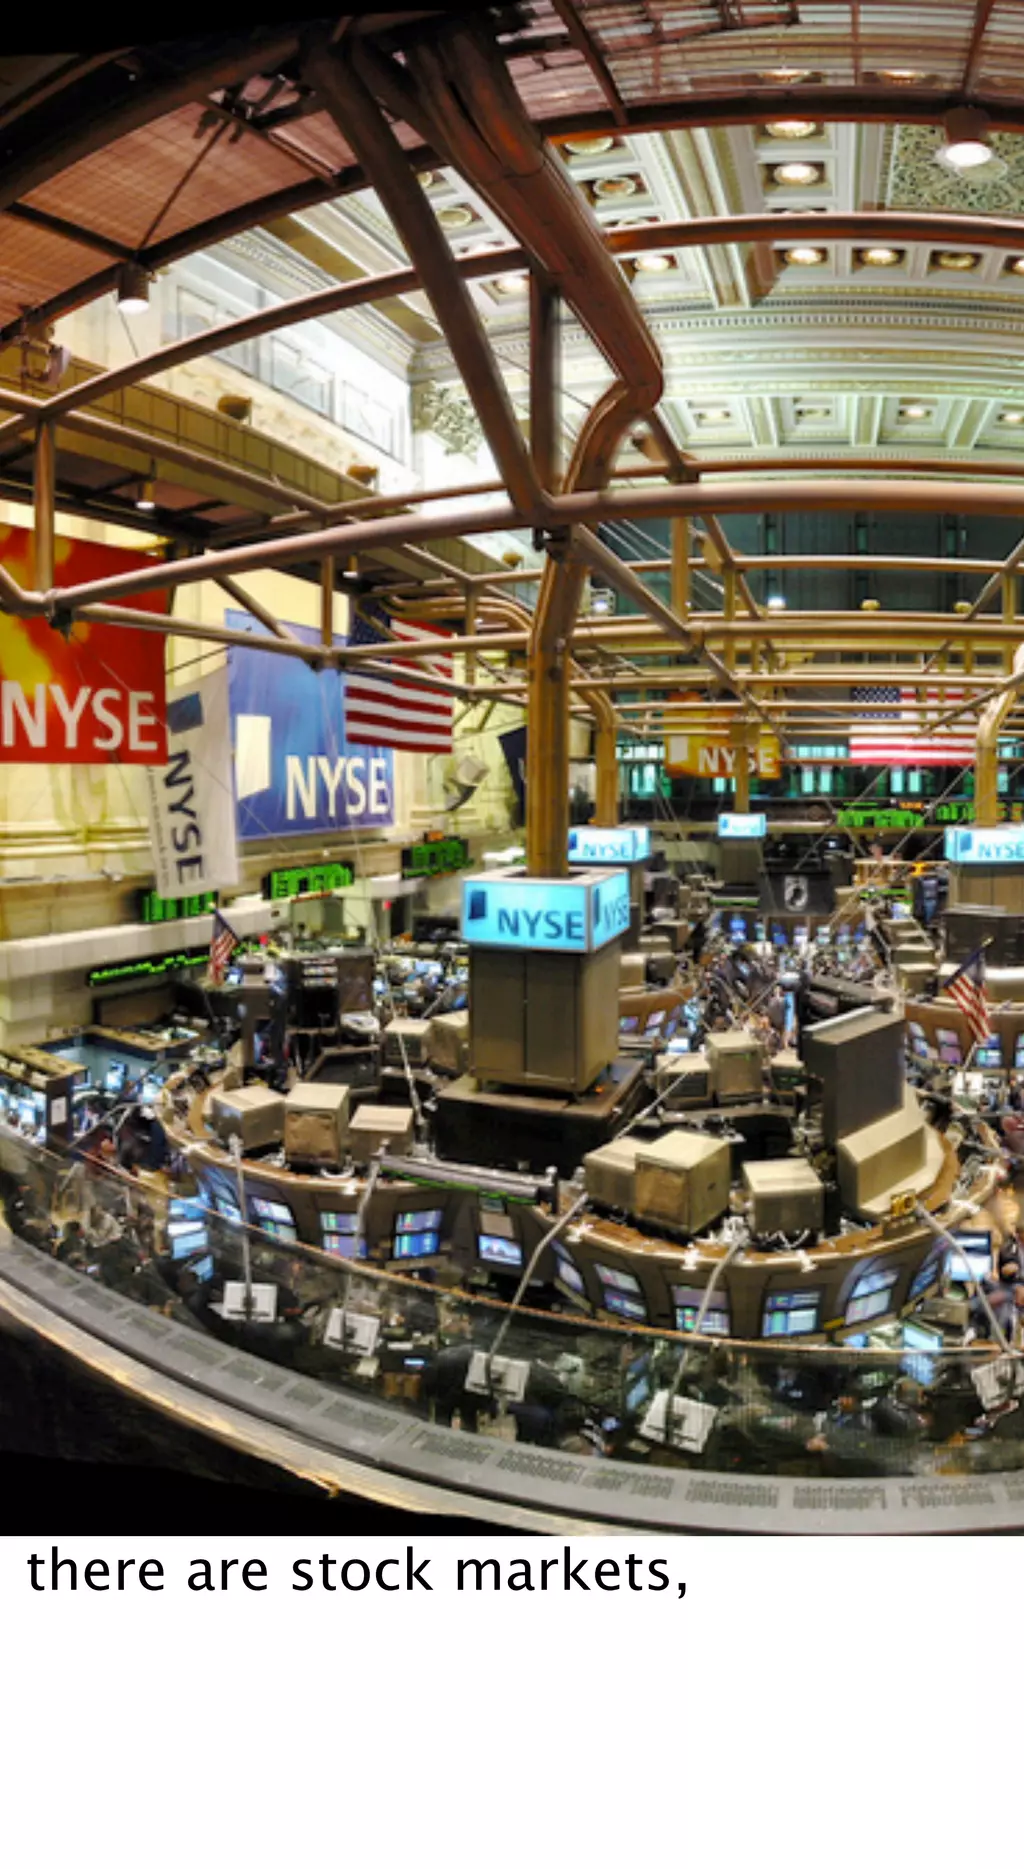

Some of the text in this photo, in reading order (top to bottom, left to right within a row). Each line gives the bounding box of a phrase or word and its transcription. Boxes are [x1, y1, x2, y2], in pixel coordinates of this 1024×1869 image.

[1, 680, 158, 751] NYSE
[163, 750, 204, 884] NYSE
[285, 755, 389, 820] NYSE
[582, 842, 631, 858] NYSE
[498, 907, 585, 941] NYSE
